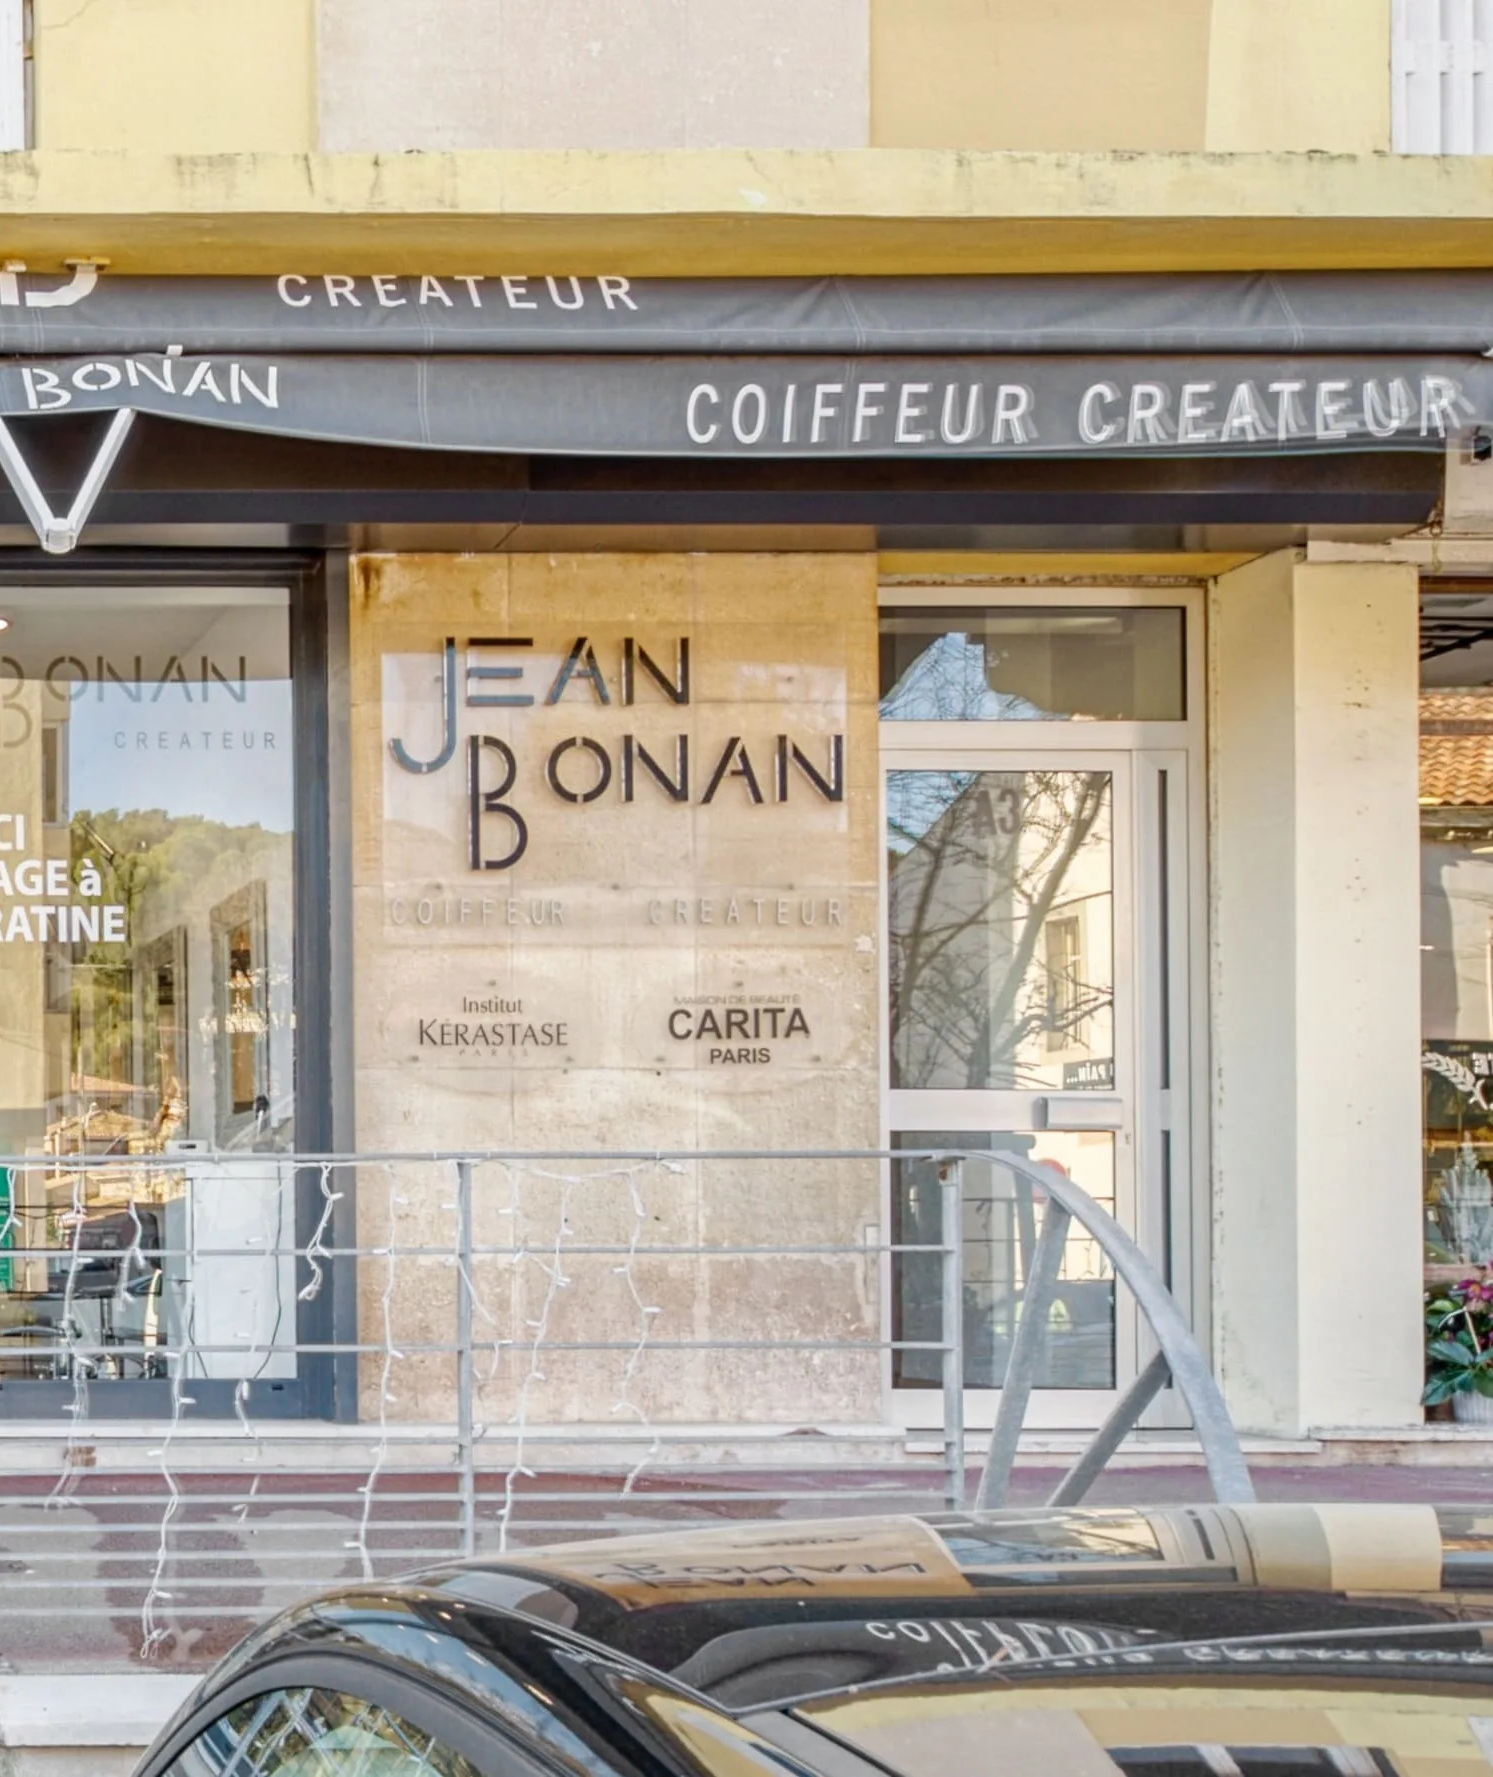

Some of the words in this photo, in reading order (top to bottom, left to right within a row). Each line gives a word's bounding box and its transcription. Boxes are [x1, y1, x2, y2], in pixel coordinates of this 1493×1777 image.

[277, 273, 638, 310] CREATEUR
[22, 357, 280, 410] BONAN
[686, 382, 1035, 444] COIFFEUR
[1078, 375, 1469, 443] CREATEUR
[388, 636, 690, 774] JEAN
[114, 731, 277, 750] CREATEUR
[467, 734, 844, 870] BONAN
[79, 858, 101, 897] à
[391, 897, 565, 925] COIFFEUR
[650, 898, 844, 927] CREATEUR
[462, 996, 523, 1014] Institut
[668, 1007, 810, 1041] CARITA
[709, 1047, 772, 1065] PARIS
